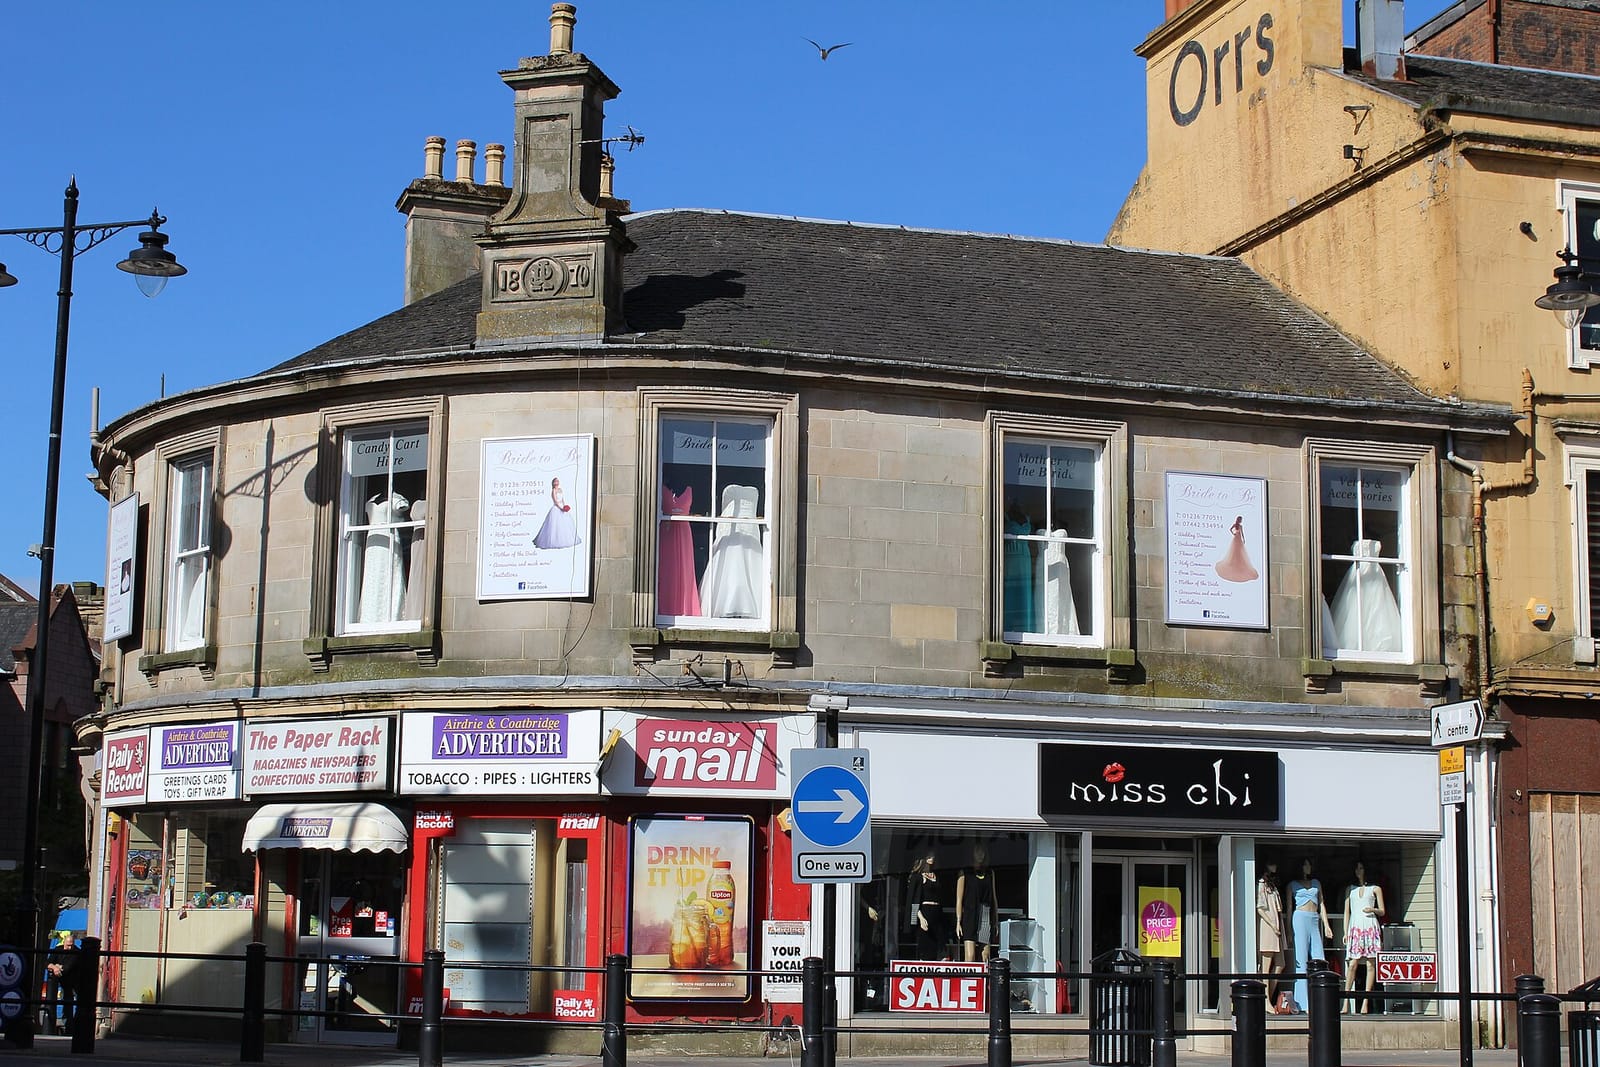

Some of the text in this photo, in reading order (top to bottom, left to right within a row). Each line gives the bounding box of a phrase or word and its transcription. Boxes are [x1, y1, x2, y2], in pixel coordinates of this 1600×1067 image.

[1169, 12, 1274, 127] Orrs
[356, 439, 420, 455] Candy Cart
[680, 436, 712, 450] Bride
[737, 440, 754, 452] Be
[376, 456, 404, 468] Hire
[500, 449, 536, 465] Bride
[1017, 452, 1062, 466] Mother
[1018, 466, 1035, 476] the
[1374, 480, 1384, 489] &
[1182, 483, 1215, 499] Bride
[1240, 488, 1256, 502] Be
[1327, 488, 1392, 502] Accesories
[444, 717, 560, 730] Airdrie & Coatbridge
[189, 730, 195, 740] &
[196, 728, 229, 740] Coatbridge
[653, 727, 741, 747] sunday
[1448, 726, 1468, 736] centre
[250, 726, 382, 752] The Paper Rack
[437, 731, 563, 755] ADVERTISER
[108, 744, 134, 772] Daily
[164, 742, 229, 766] ADVERTISER
[644, 729, 767, 782] mail
[253, 755, 376, 771] MAGAZINES NEWSPAPERS
[106, 766, 145, 793] Record
[164, 774, 227, 786] GREETINGS CARDS
[251, 771, 378, 787] CONFECTIONS STATIONERY
[408, 773, 470, 785] TOBACCO
[483, 772, 517, 785] PIPES
[531, 772, 592, 784] LIGHTERS
[1070, 759, 1252, 807] miss chi
[164, 789, 180, 798] TOYS
[187, 788, 202, 798] GIFT
[204, 787, 227, 797] WRAP
[416, 811, 442, 820] Daily
[560, 813, 600, 829] mail
[283, 826, 328, 836] ADVERTISER
[416, 820, 454, 829] Record
[647, 846, 720, 865] DRINK
[805, 860, 859, 872] One way
[647, 868, 706, 887] IT UP
[332, 916, 351, 926] Free
[1147, 918, 1172, 928] PRICE
[332, 926, 351, 935] data
[1141, 929, 1179, 944] SALE
[772, 946, 801, 956] YOUR
[770, 961, 803, 970] LOCAL
[1380, 964, 1433, 980] SALE
[898, 977, 977, 1008] SALE
[555, 997, 582, 1010] Daily
[555, 1007, 595, 1018] Record
